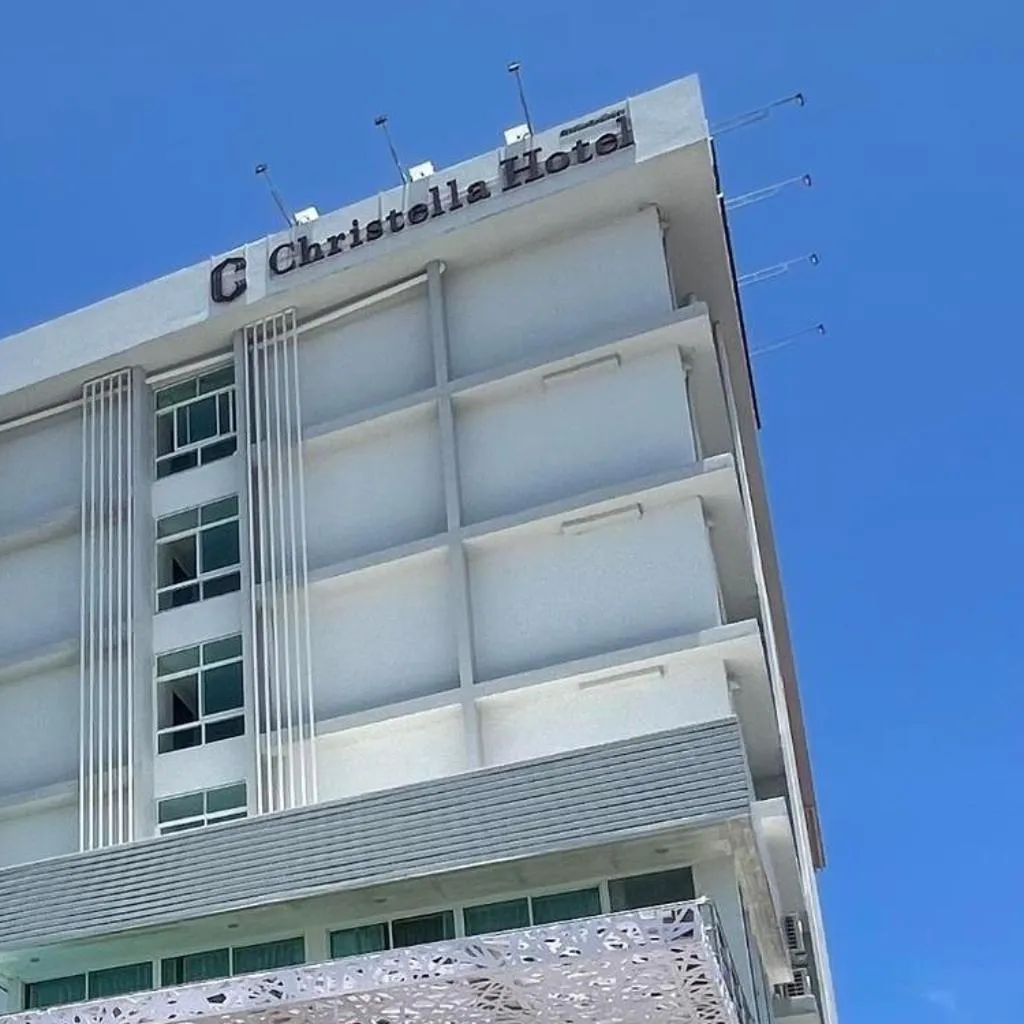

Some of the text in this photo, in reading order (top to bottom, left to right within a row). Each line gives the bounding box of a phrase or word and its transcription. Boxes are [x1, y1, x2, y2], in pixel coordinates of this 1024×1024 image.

[211, 116, 635, 303] C Christella Hotel
